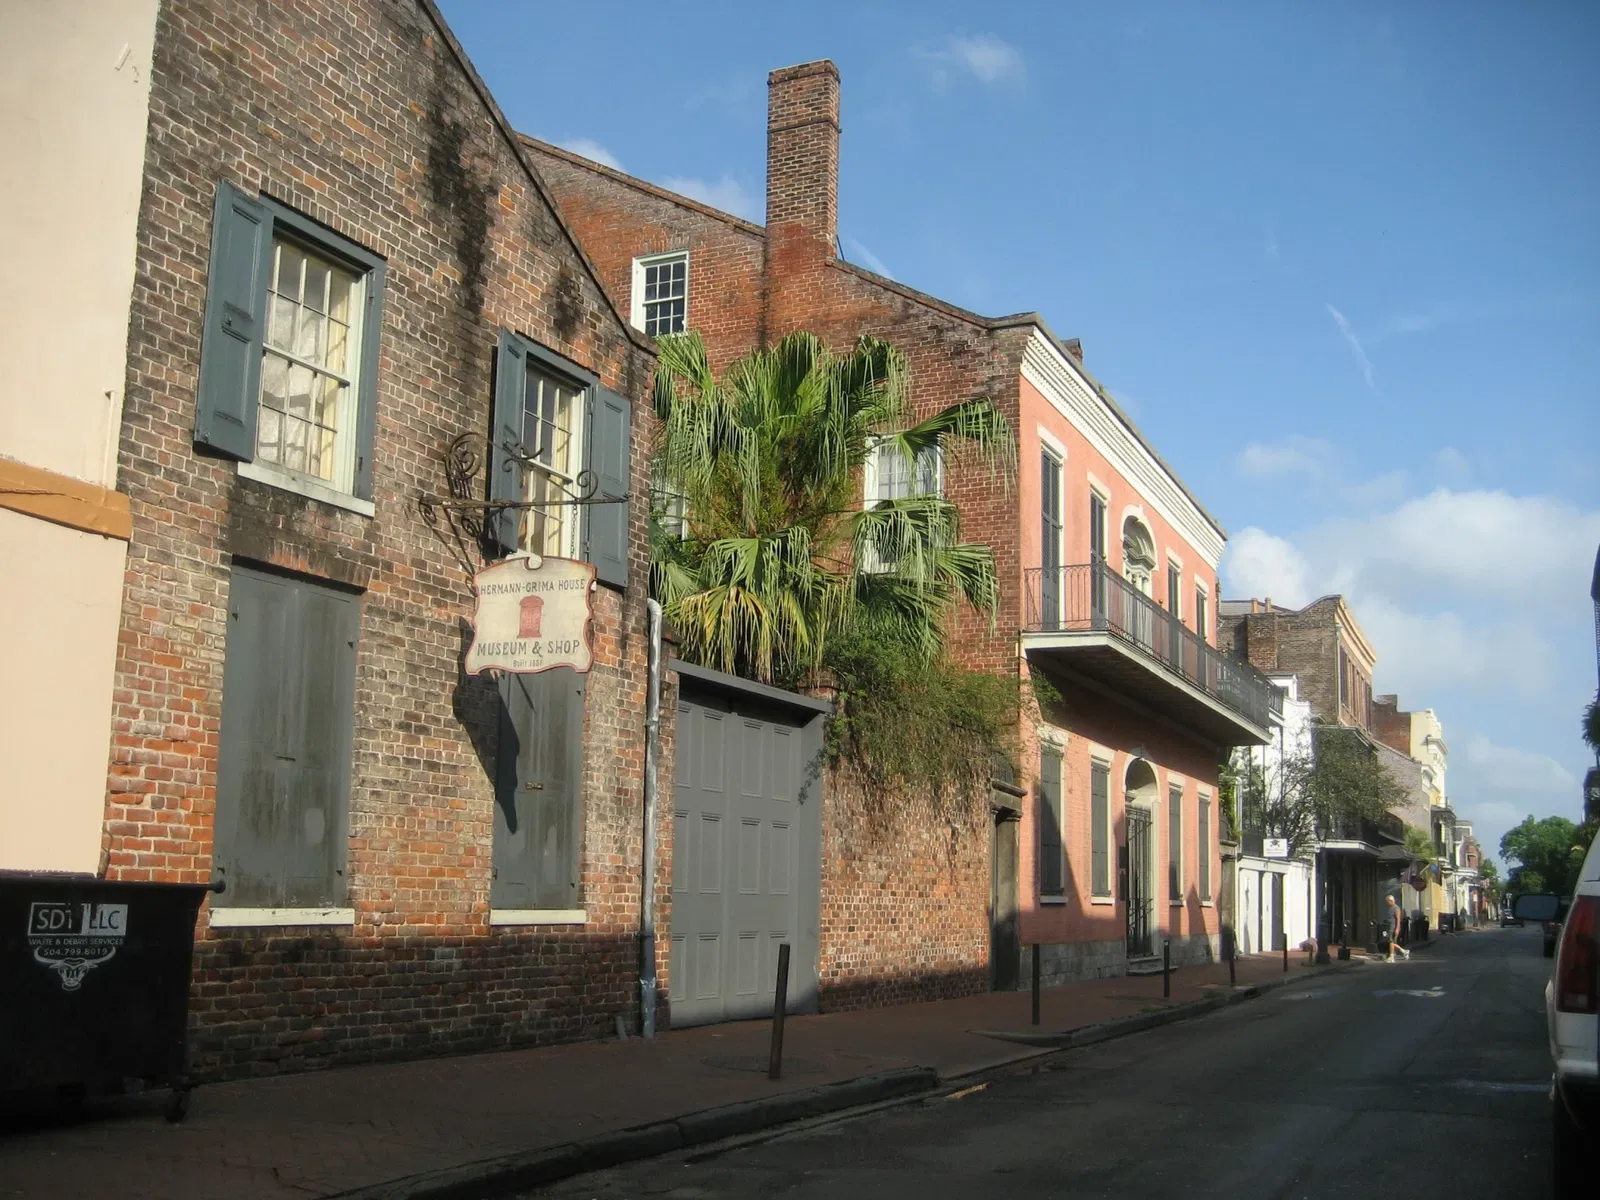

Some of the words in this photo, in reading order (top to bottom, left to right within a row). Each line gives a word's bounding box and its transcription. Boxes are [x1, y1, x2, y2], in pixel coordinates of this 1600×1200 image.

[480, 580, 555, 595] HERMANN-GRIMA
[558, 578, 586, 590] HOUSE
[476, 641, 527, 657] MUSEUM
[531, 641, 543, 658] &
[547, 639, 580, 655] SHOP
[89, 910, 121, 930] LLC
[28, 938, 53, 946] WASTE
[55, 938, 61, 946] &
[63, 938, 89, 946] DEBRIS
[90, 938, 124, 946] SERVICES
[43, 948, 108, 956] 504.799.8019
